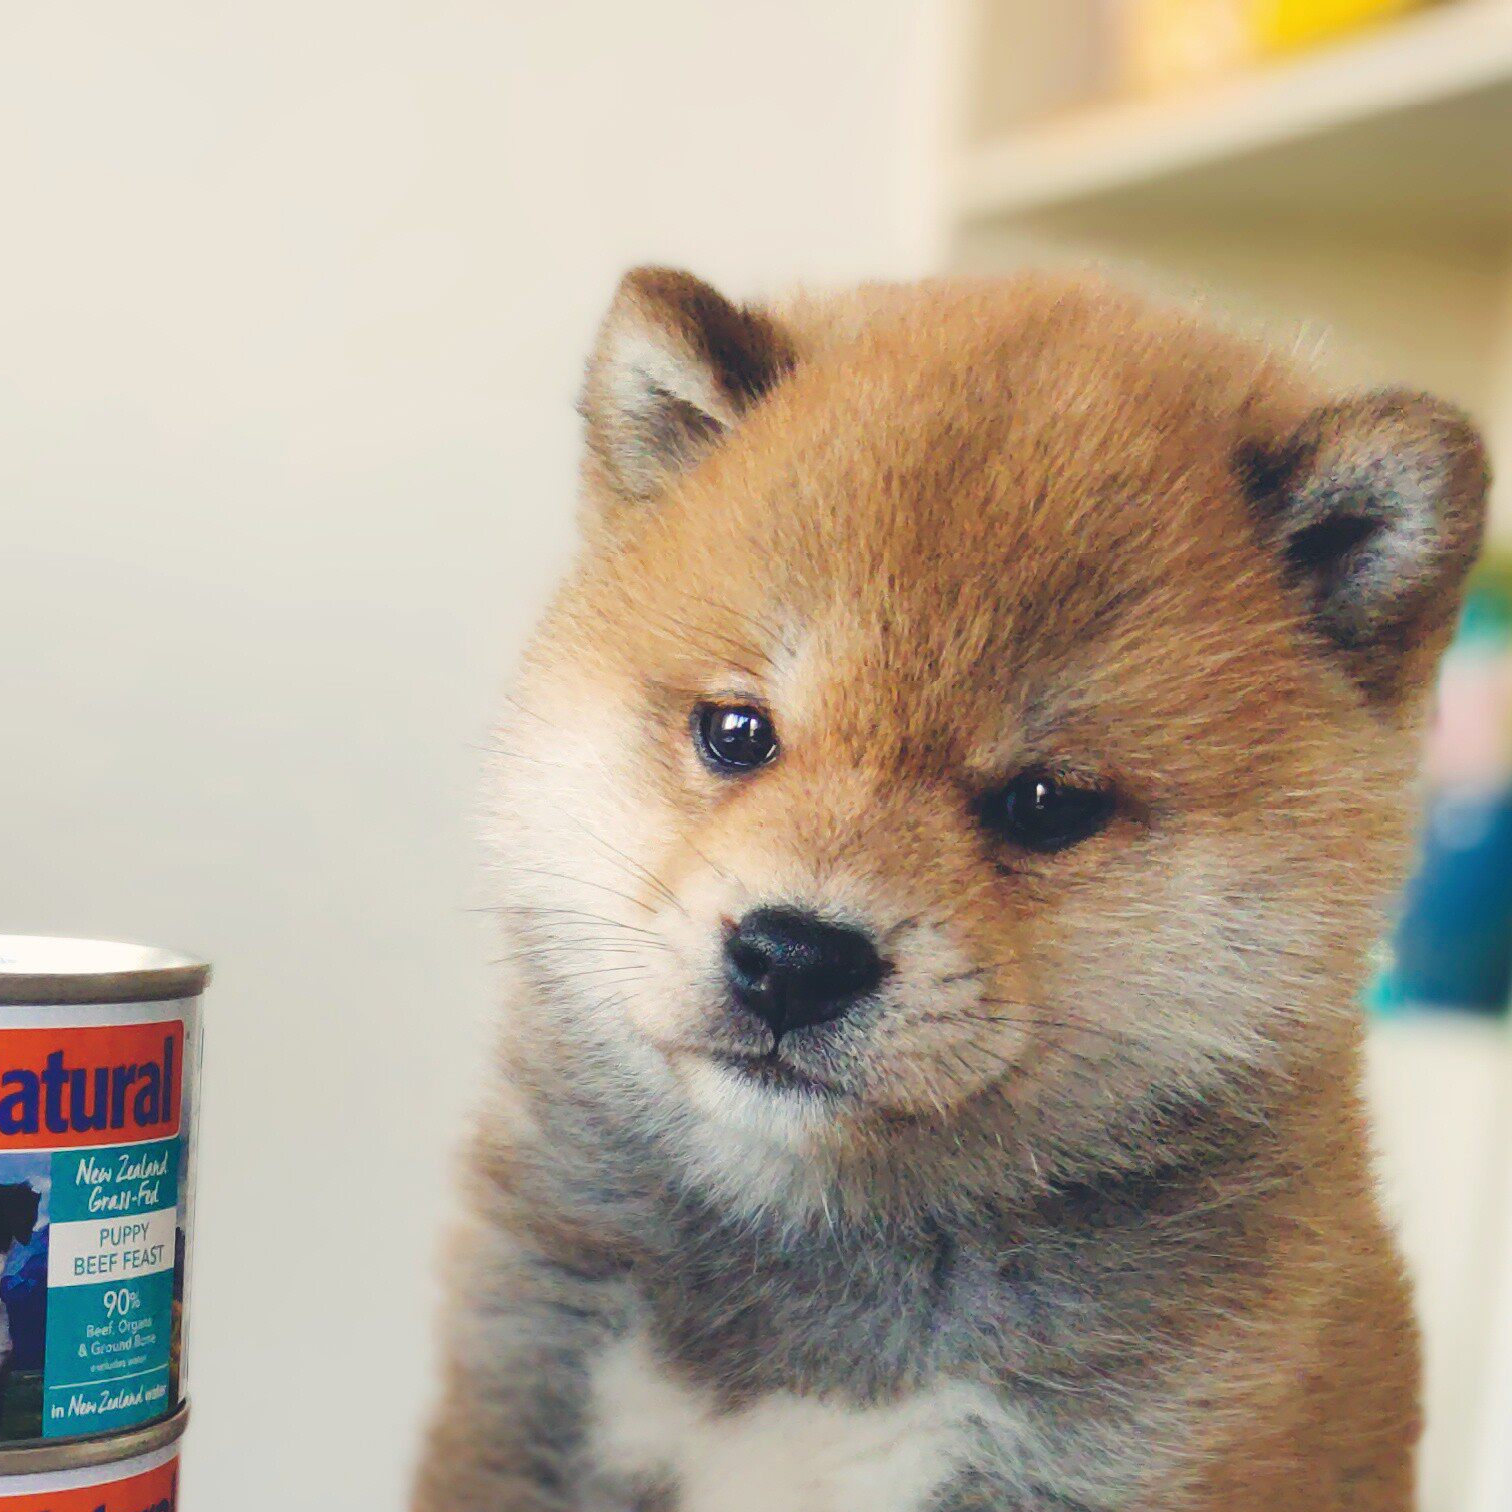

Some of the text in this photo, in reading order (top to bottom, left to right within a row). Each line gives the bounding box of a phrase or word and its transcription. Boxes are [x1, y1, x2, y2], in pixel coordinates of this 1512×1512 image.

[75, 1150, 169, 1186] New Zealand
[100, 1221, 150, 1248] PUPPY
[74, 1244, 165, 1277] BEEF FEAST
[103, 1288, 141, 1319] 90%
[91, 1338, 132, 1355] Ground
[51, 1403, 65, 1419] in
[67, 1393, 97, 1418] New
[97, 1384, 144, 1414] Zealand
